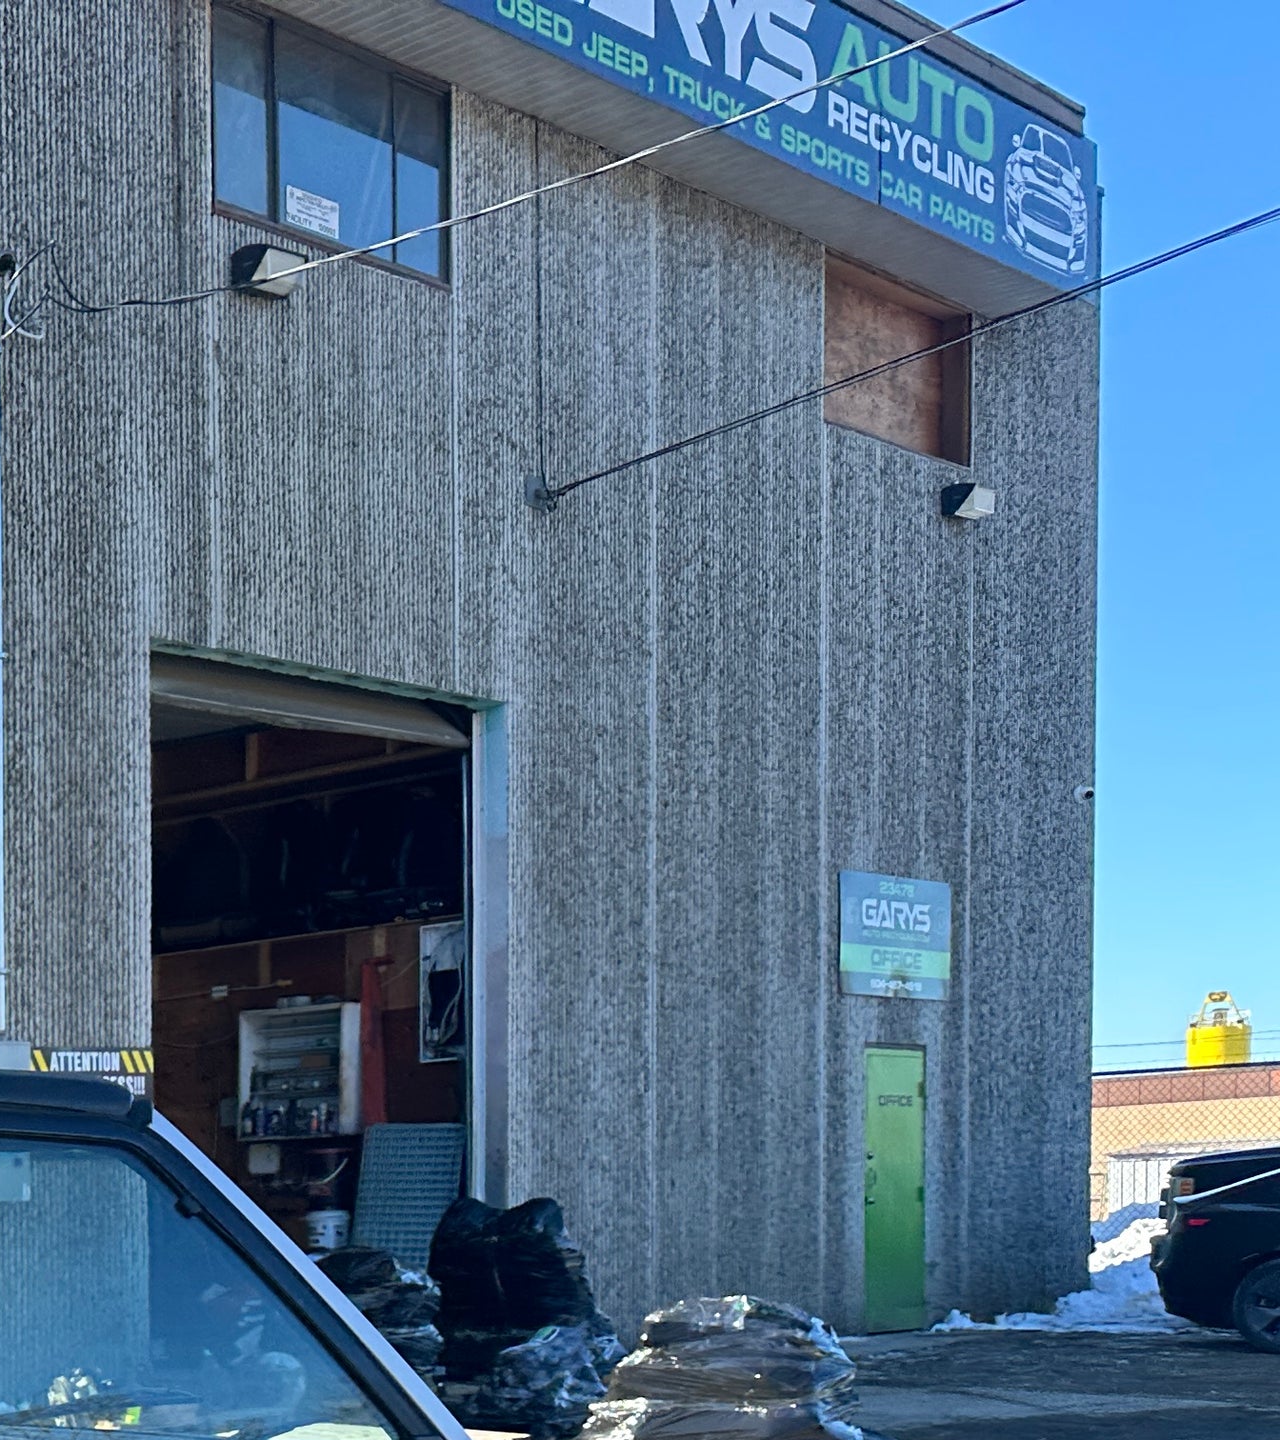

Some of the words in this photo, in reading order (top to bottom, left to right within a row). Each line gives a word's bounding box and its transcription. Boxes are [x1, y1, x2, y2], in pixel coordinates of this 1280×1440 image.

[831, 22, 994, 163] AUTO
[496, 0, 573, 47] USED
[582, 31, 654, 93] JEEP,
[662, 65, 747, 128] TRUCK
[755, 112, 772, 141] &
[780, 123, 871, 188] SPORTS
[880, 171, 923, 211] CAR
[929, 196, 995, 244] PARTS
[827, 90, 995, 204] RECYCLING
[862, 898, 931, 933] GARYS
[871, 948, 923, 970] OFFICE
[50, 1051, 121, 1072] ATTENTION
[878, 1094, 913, 1107] OFFICE
